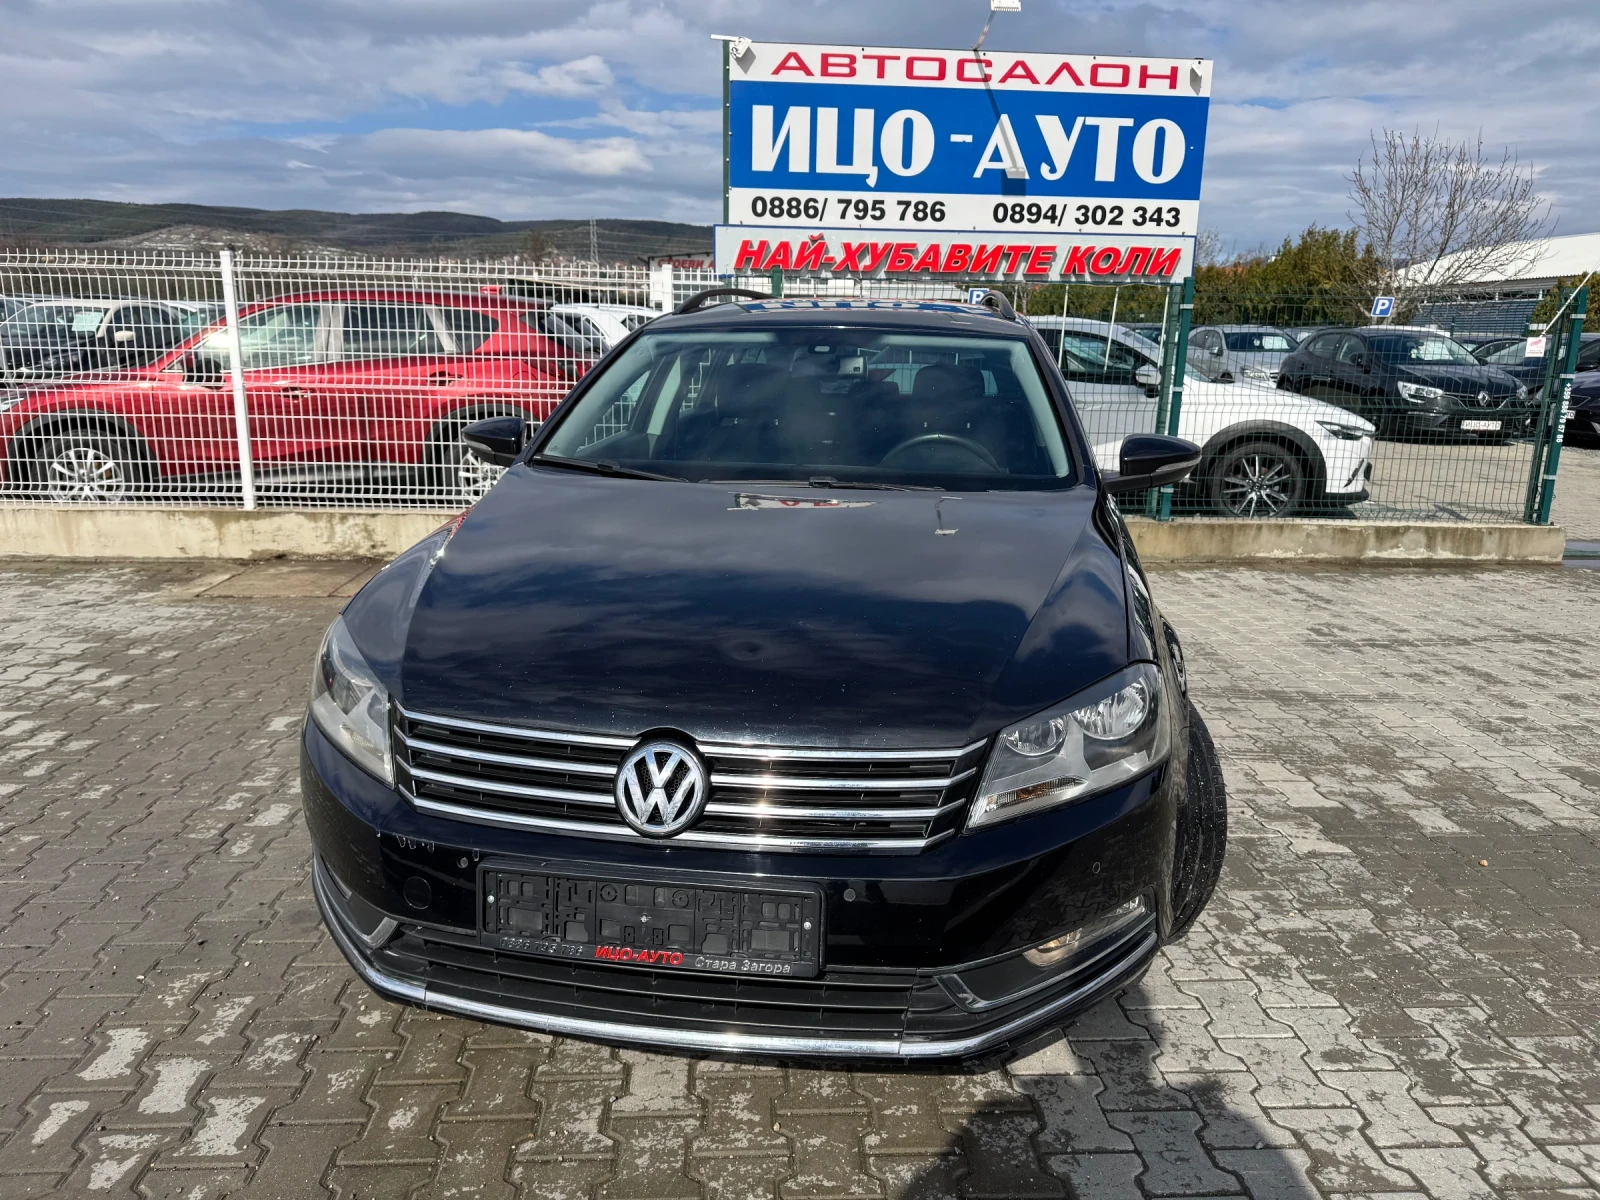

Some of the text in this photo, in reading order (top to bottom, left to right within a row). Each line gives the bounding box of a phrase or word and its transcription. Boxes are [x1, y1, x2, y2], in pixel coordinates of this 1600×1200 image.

[771, 52, 1179, 90] АВТОСАЛОН
[751, 196, 946, 222] 0886/ 795 786
[993, 203, 1181, 227] 0894/ 302 343
[733, 233, 1182, 276] НАЙ-ХУБАВИТЕ КОЛИ
[1375, 299, 1389, 315] P
[595, 945, 791, 975] ИЦО-АУТО Стара Загора
